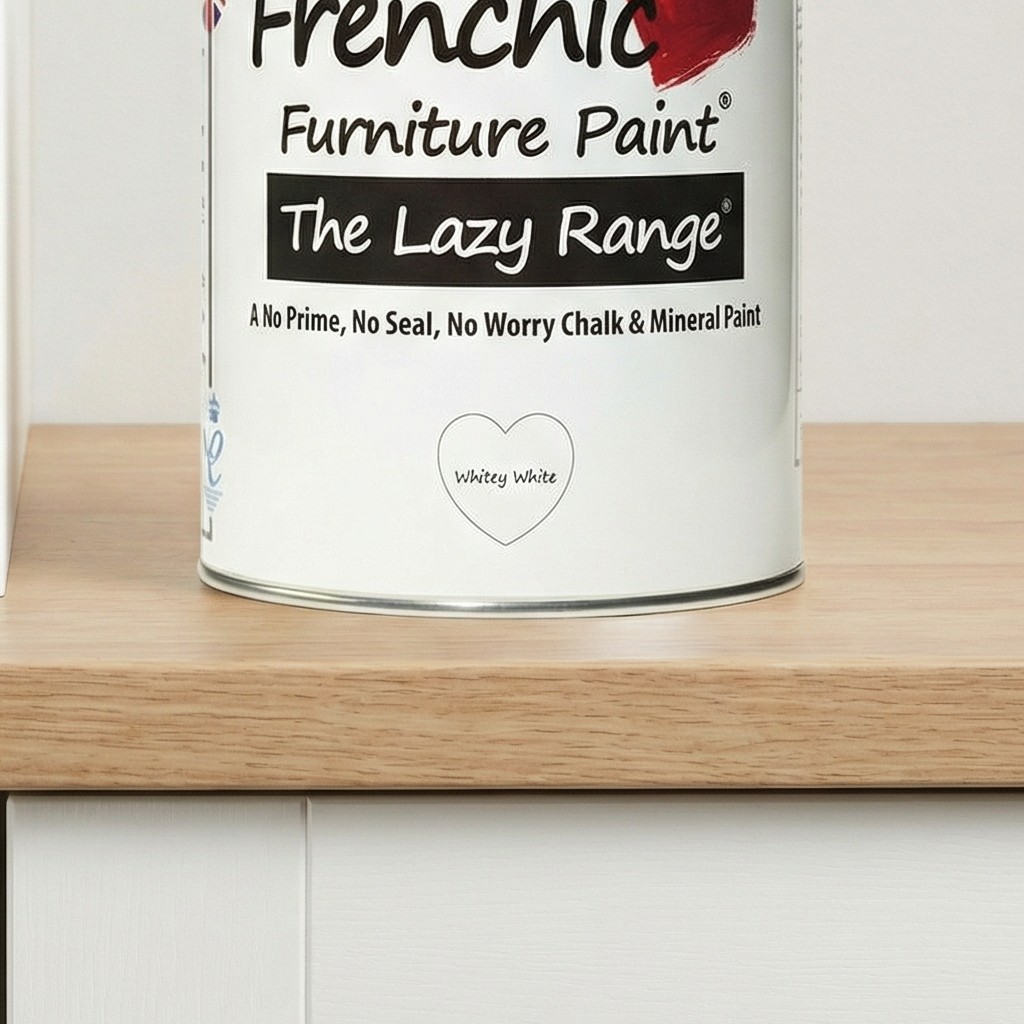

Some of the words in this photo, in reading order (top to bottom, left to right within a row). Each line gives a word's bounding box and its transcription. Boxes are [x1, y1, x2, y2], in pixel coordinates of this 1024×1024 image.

[281, 99, 550, 158] Furniture
[280, 196, 372, 254] The
[393, 205, 533, 275] Lazy
[249, 302, 259, 327] A
[263, 303, 282, 329] No
[286, 305, 347, 337] Prime,
[352, 309, 380, 335] No
[385, 310, 441, 340] Seal,
[447, 311, 478, 337] No
[483, 311, 556, 343] Worry
[561, 309, 624, 336] Chalk
[628, 309, 645, 335] &
[649, 304, 721, 334] Mineral
[724, 302, 761, 329] Paint
[454, 468, 508, 489] Whitey
[513, 468, 557, 484] White
